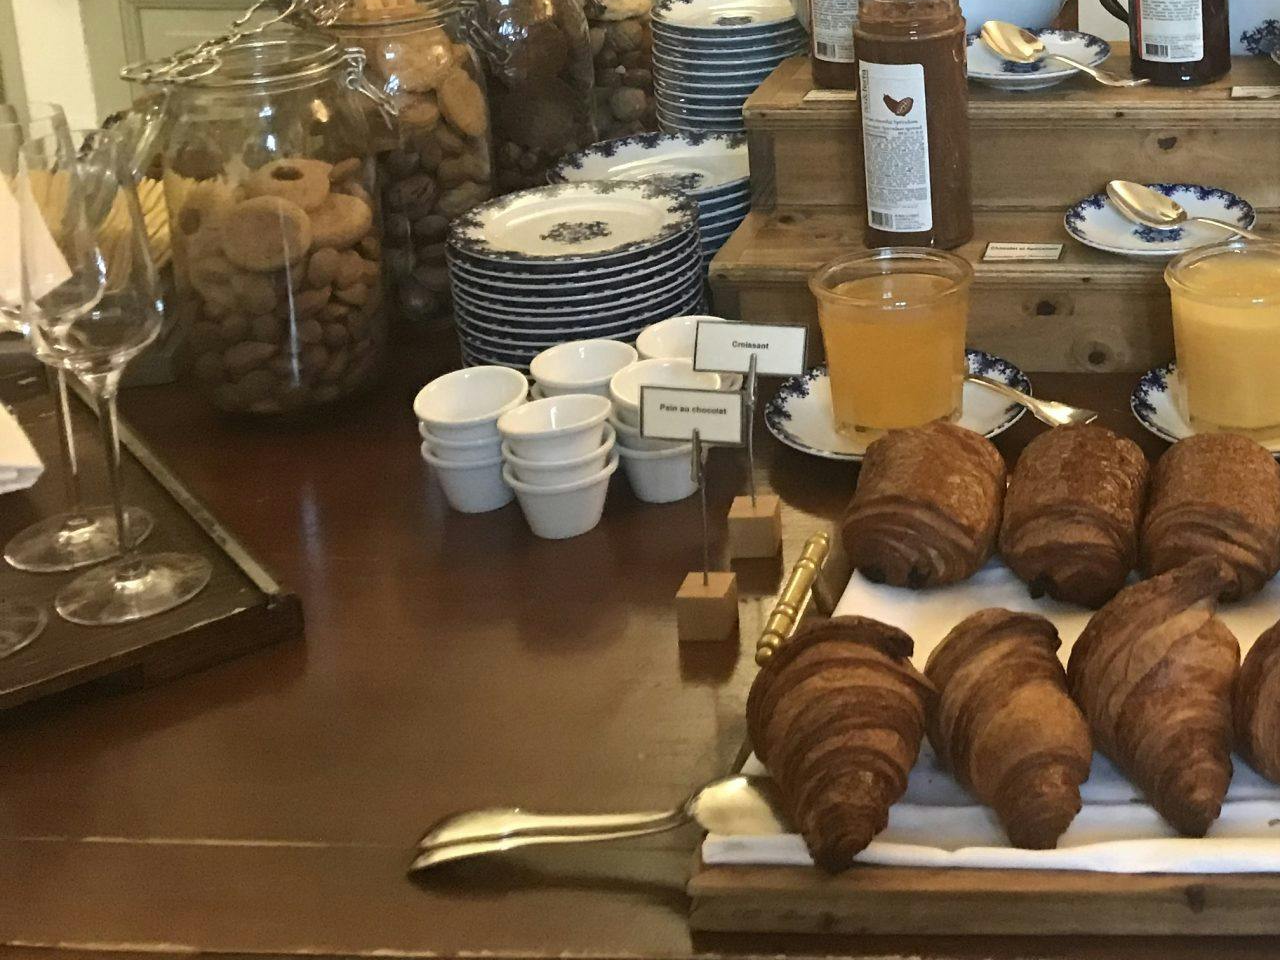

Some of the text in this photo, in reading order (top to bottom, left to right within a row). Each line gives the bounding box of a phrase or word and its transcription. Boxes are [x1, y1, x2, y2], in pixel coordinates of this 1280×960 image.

[732, 340, 769, 350] Croissant
[659, 403, 727, 415] Pain au chocolat
